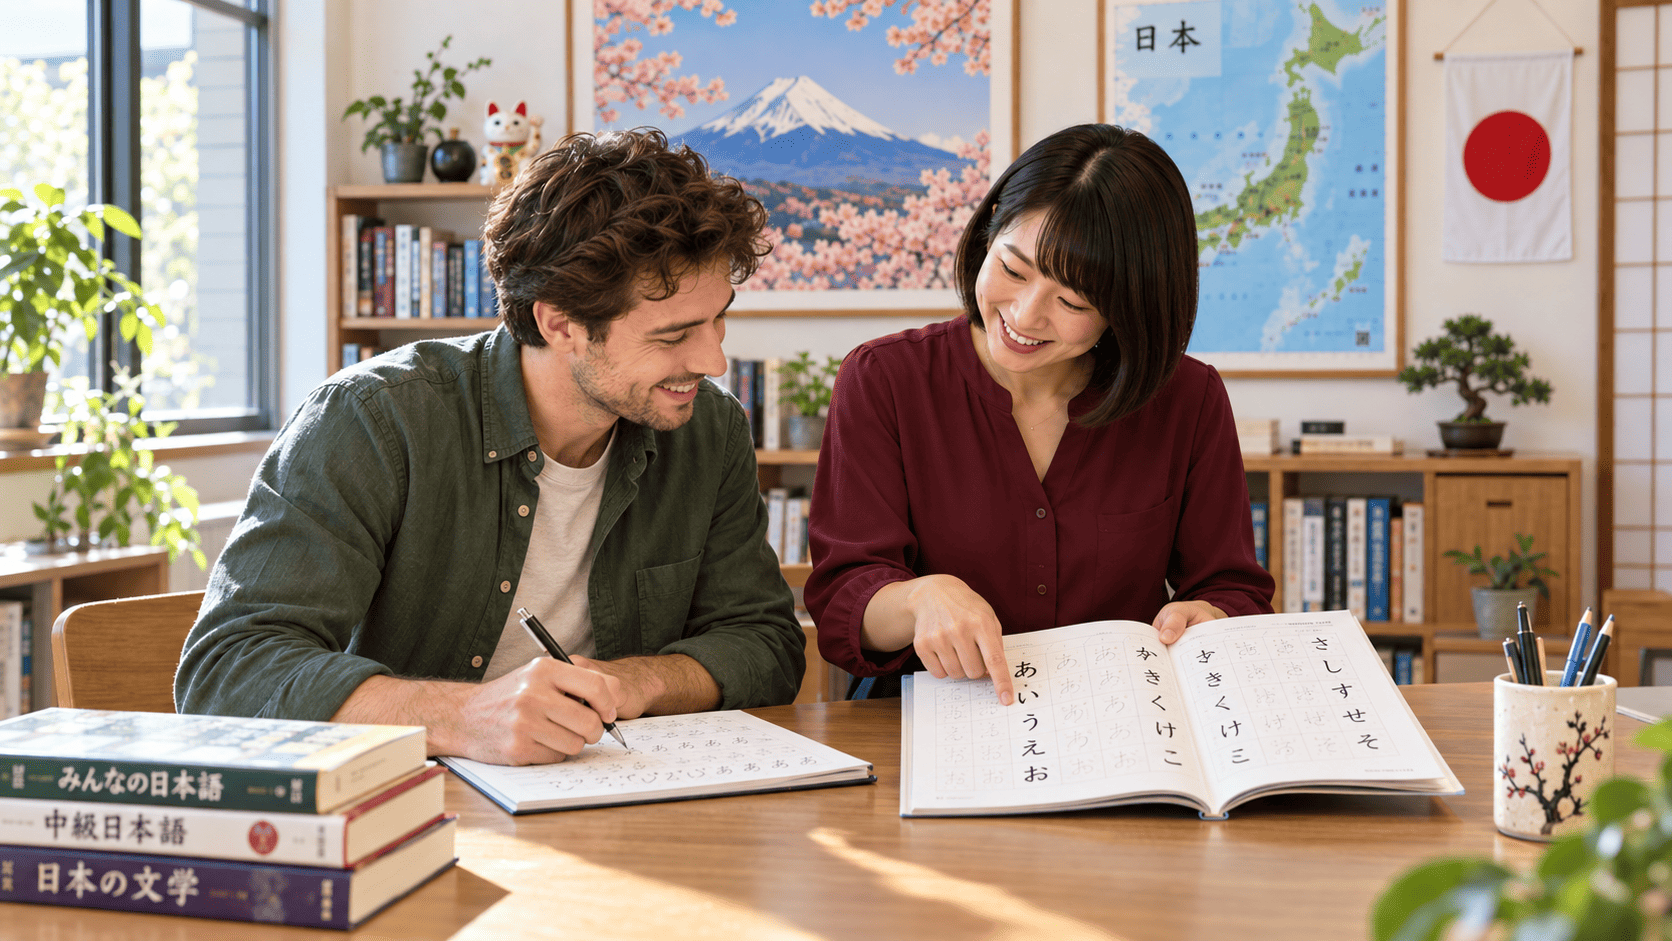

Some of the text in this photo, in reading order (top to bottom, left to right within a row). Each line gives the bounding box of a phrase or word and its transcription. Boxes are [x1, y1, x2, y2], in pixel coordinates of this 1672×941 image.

[1136, 20, 1201, 53] 日本
[1311, 637, 1379, 750] さしすせそ
[1015, 661, 1048, 782] あいうえお
[57, 765, 224, 802] みんなの日本語
[45, 808, 188, 846] 中級日本語
[37, 861, 200, 907] 日本の文学
